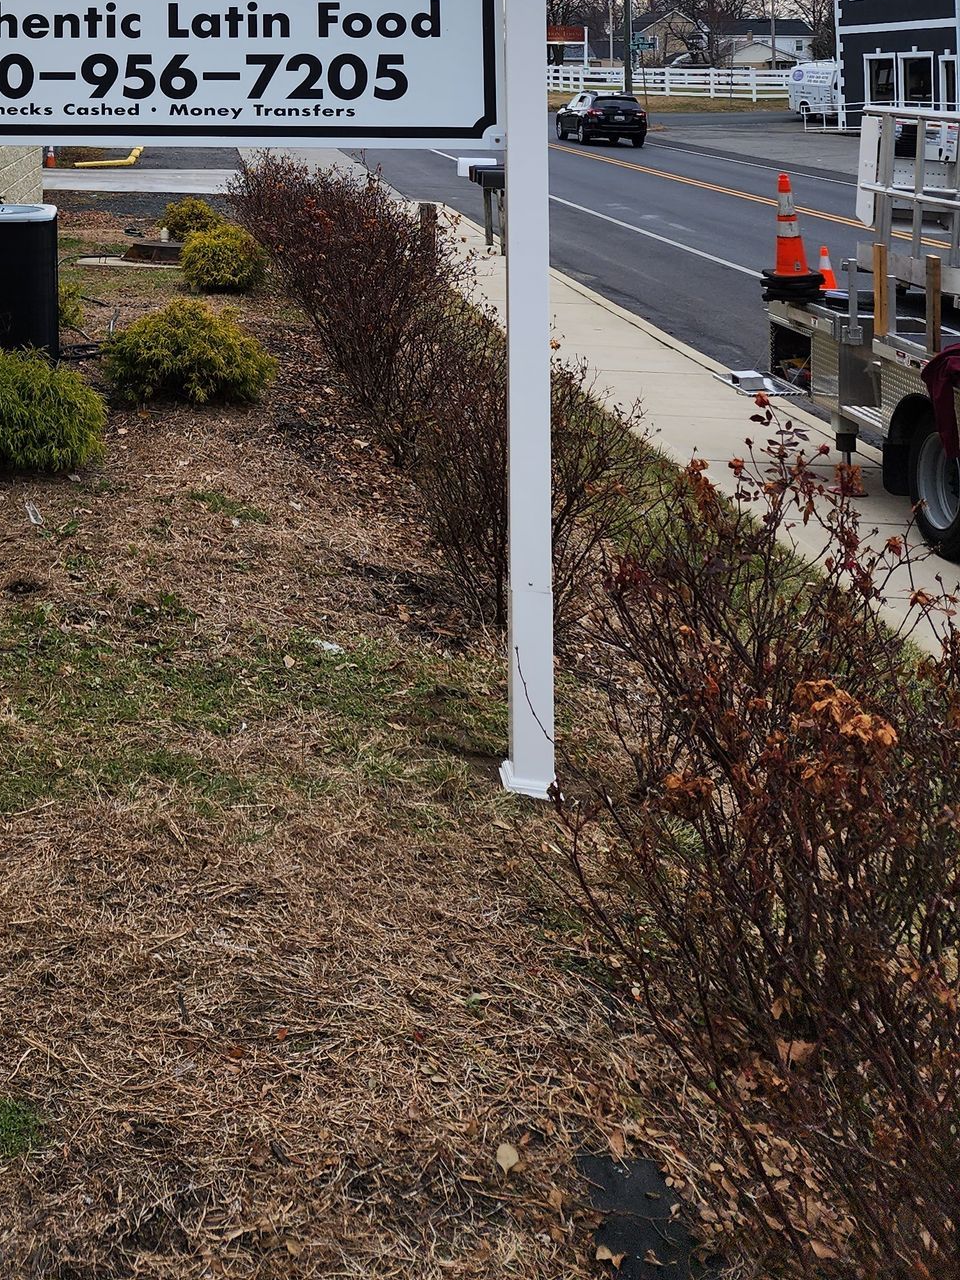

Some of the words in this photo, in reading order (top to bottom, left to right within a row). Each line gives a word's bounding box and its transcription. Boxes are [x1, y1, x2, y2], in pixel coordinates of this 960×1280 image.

[168, 2, 290, 38] Latin
[318, 0, 441, 38] Food
[63, 103, 140, 116] Cashed
[169, 104, 243, 119] Money
[253, 104, 356, 117] Transfers
